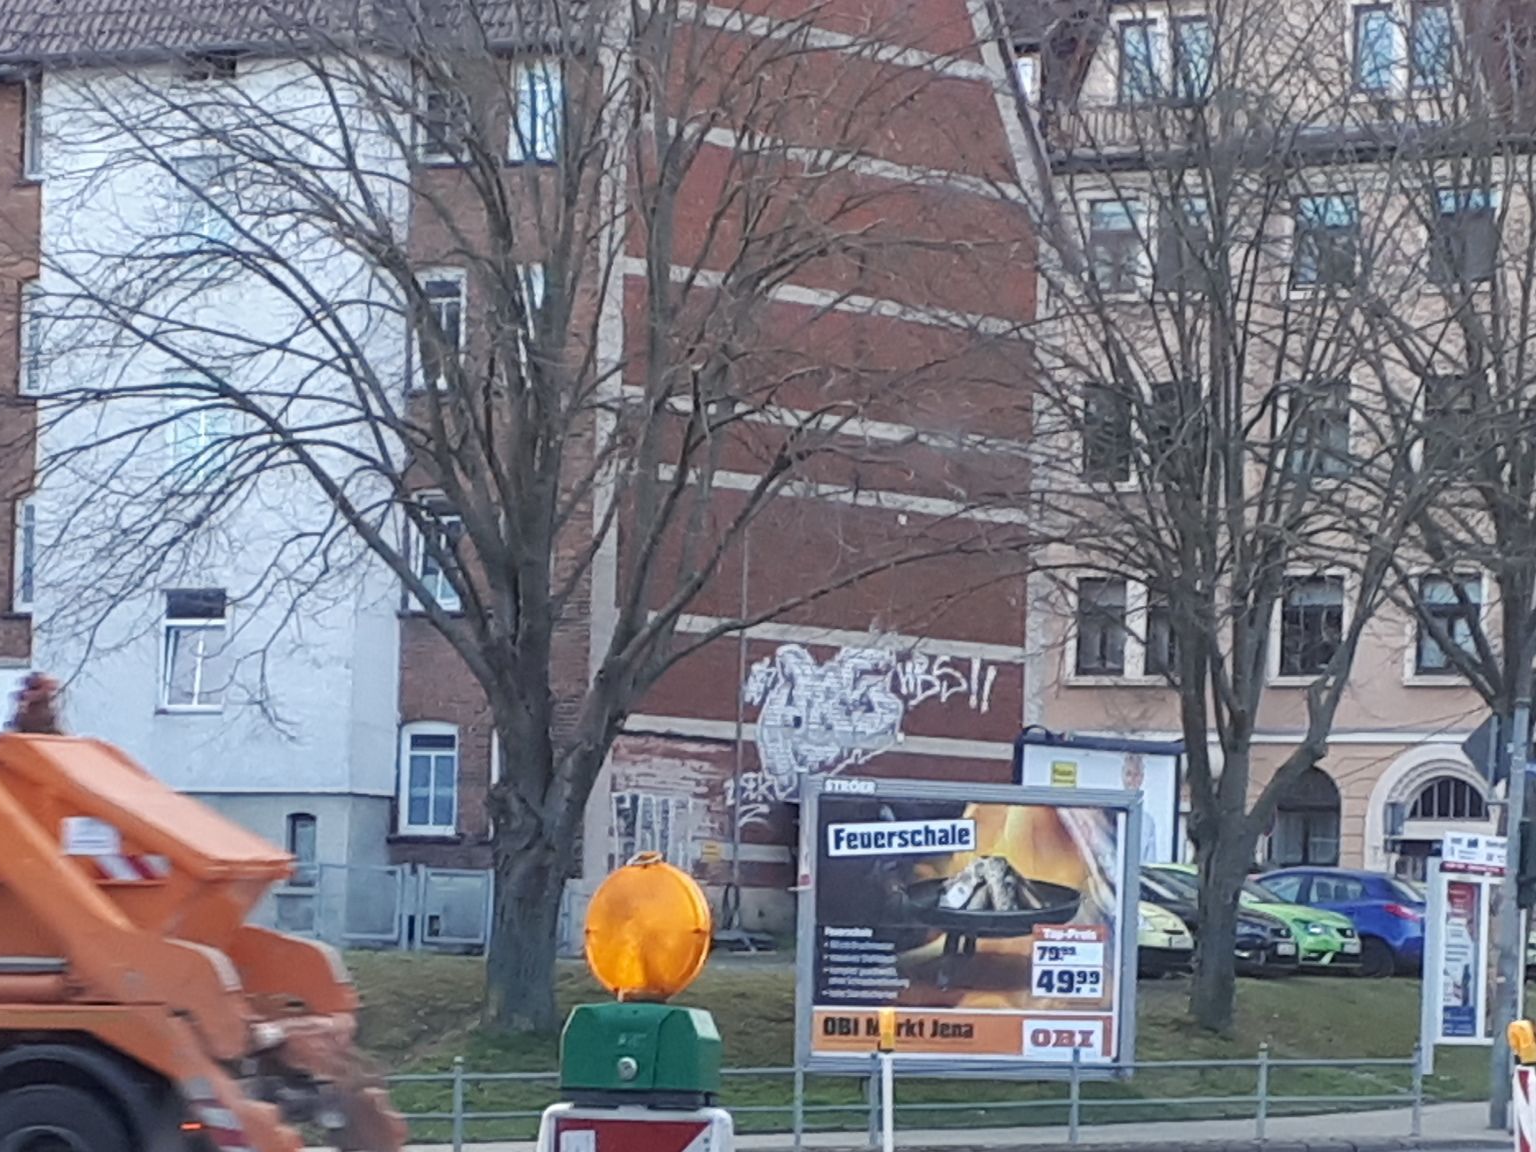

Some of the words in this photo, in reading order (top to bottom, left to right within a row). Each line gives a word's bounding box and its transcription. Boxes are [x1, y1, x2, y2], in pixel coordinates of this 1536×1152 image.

[824, 779, 876, 794] STRÖER
[833, 824, 971, 850] Feuerschale
[823, 1016, 859, 1036] OBI
[866, 1017, 925, 1038] Mrkt
[930, 1019, 974, 1039] Jena
[1030, 1028, 1094, 1048] OBI
